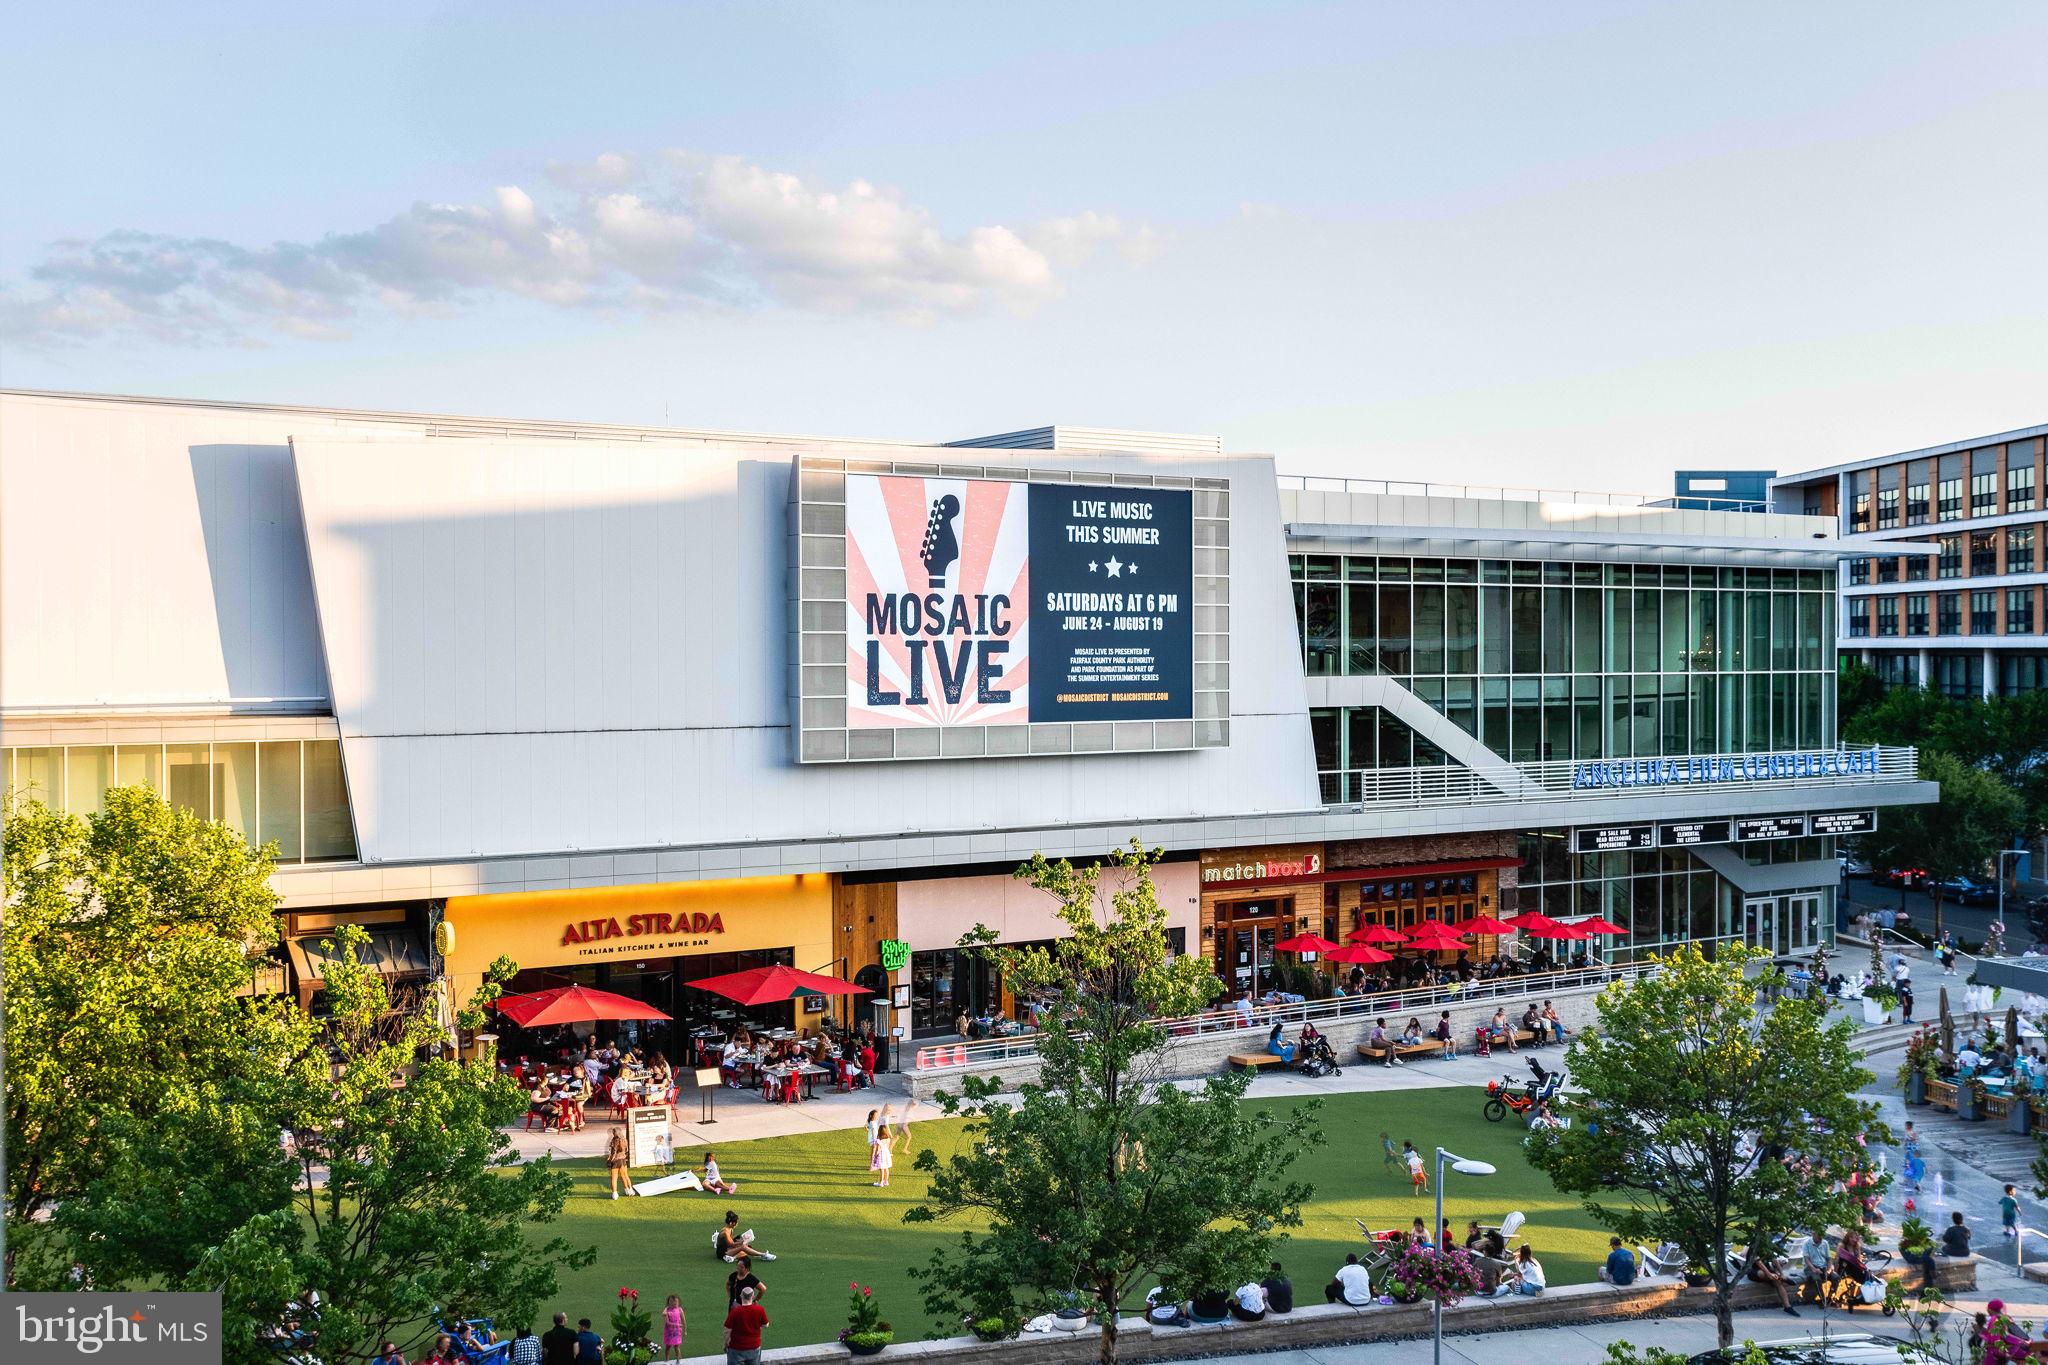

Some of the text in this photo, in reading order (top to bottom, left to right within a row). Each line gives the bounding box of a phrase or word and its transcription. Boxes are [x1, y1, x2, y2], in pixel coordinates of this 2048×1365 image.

[1072, 500, 1153, 520] LIVE MUSIC
[1066, 525, 1160, 545] THIS SUMMER
[1047, 592, 1178, 612] SATURDAYS AT 6 PM
[867, 593, 1011, 636] MOSAIC
[1062, 616, 1088, 631] JUNE
[1090, 616, 1103, 631] 24
[1113, 617, 1151, 631] AUGUST
[1152, 617, 1163, 631] 19
[1127, 656, 1154, 664] AUTHORITY
[867, 640, 1011, 706] LIVE
[1100, 674, 1141, 682] ENTERTAINMENT
[1056, 692, 1169, 703] @MOSAICDISTRICT MOSAICDISTRICT.COM
[1574, 759, 1681, 789] ANGELIKA
[1688, 756, 1737, 783] FILM
[1742, 753, 1815, 780] CENTER
[1820, 754, 1829, 775] &
[1598, 841, 1627, 849] OPPENHEIMER
[1205, 861, 1303, 882] matchbox
[1249, 906, 1259, 914] 120
[563, 912, 725, 946] ALTA STRADA
[579, 947, 614, 956] ITALIAN
[618, 944, 655, 953] KITCHEN
[881, 939, 912, 957] Kirby
[882, 953, 907, 968] Club
